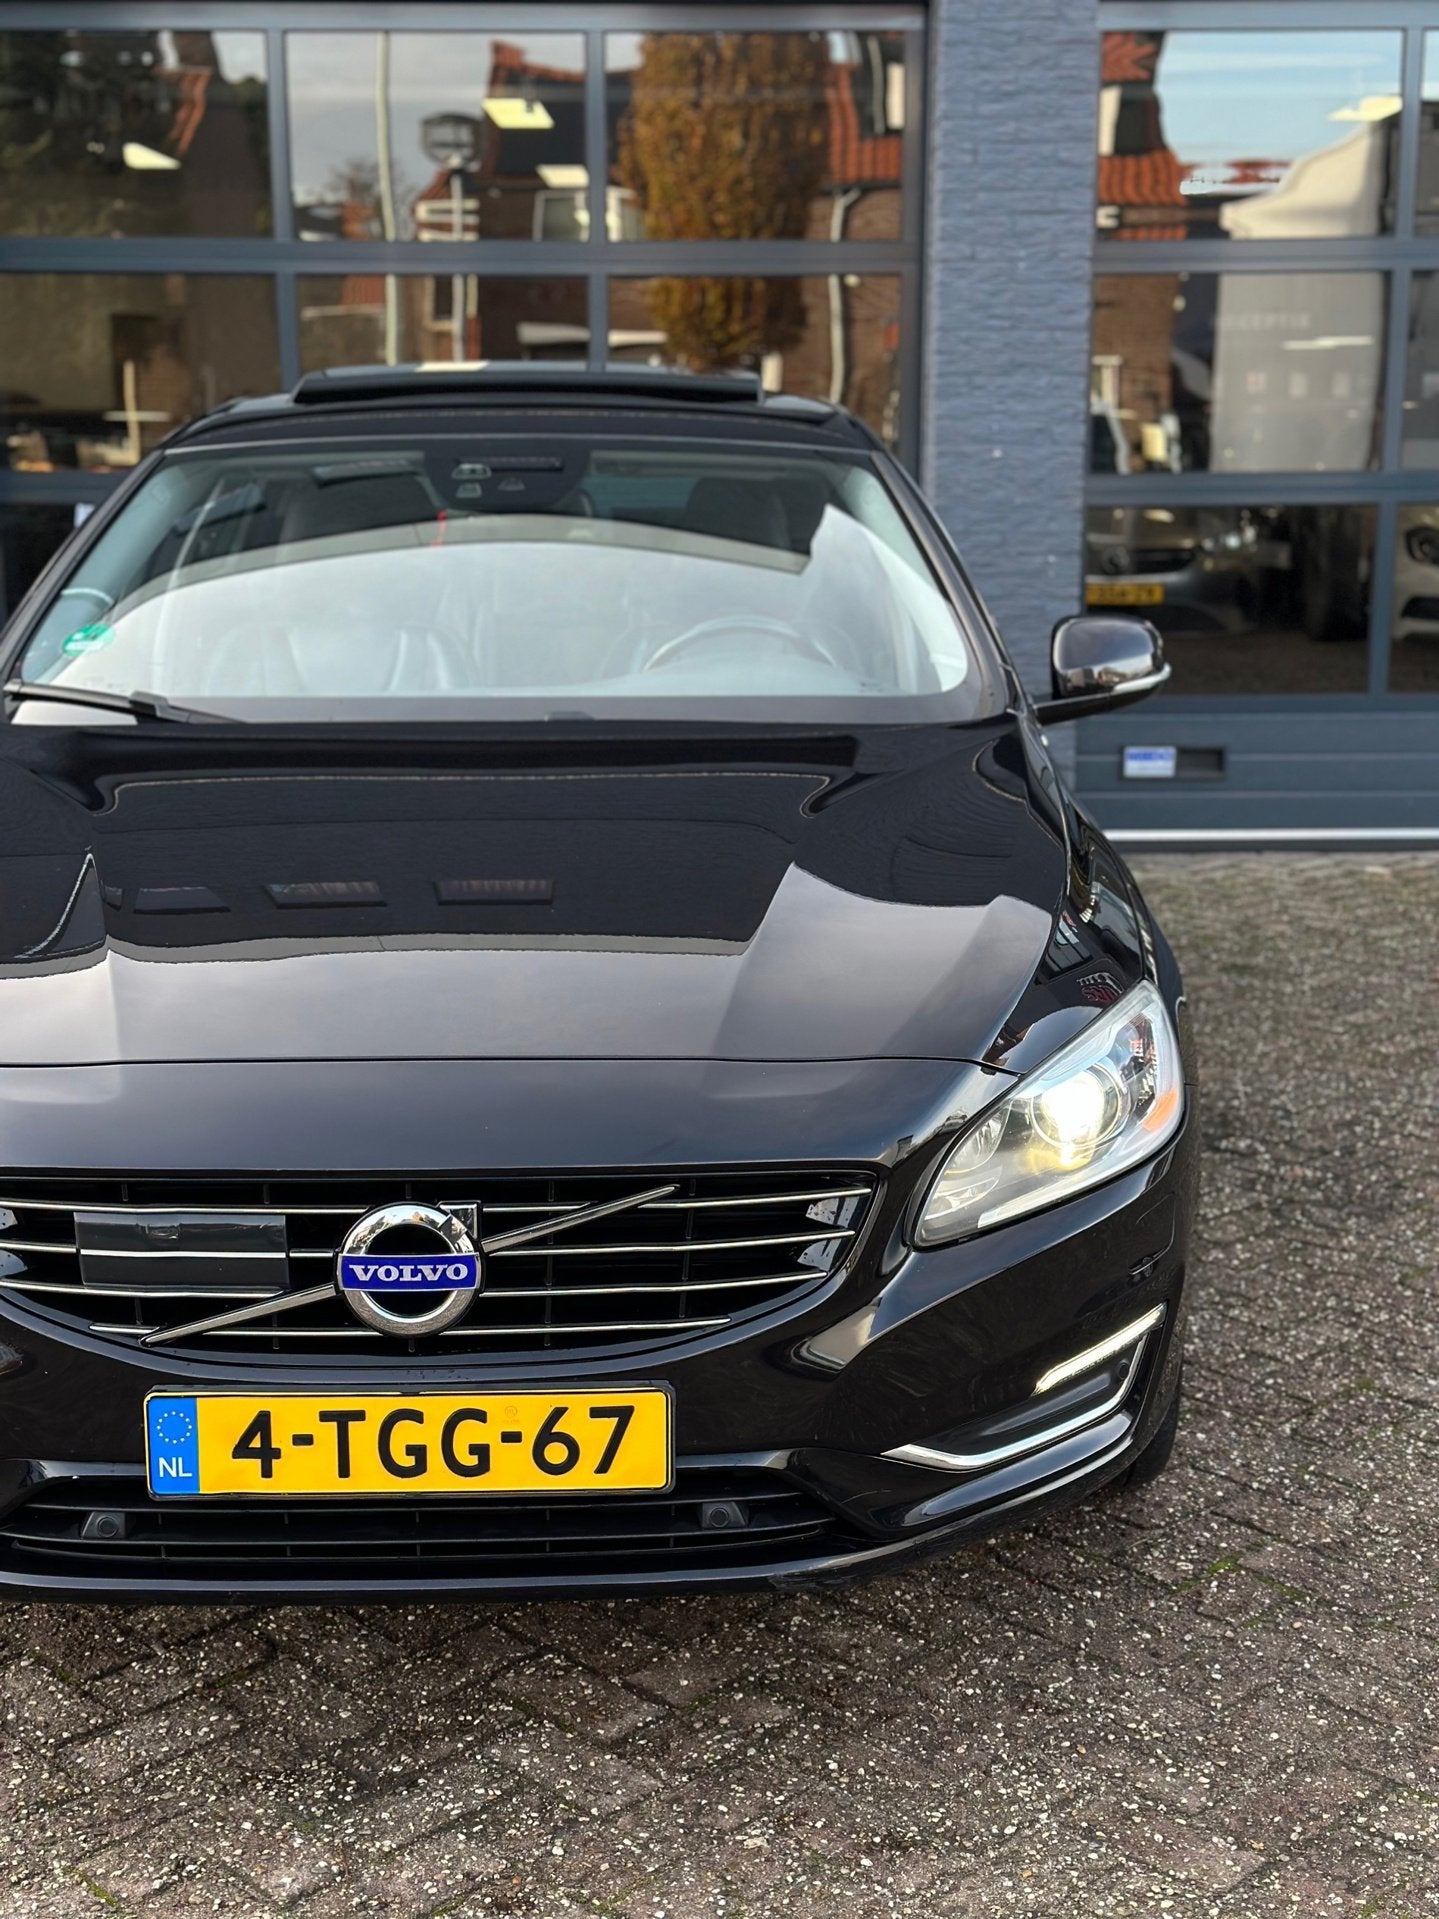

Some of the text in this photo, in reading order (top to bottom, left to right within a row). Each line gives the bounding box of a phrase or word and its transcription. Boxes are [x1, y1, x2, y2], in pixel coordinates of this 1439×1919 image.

[349, 1263, 468, 1282] VOLVO
[231, 1405, 635, 1479] 4-TGG-67
[158, 1456, 193, 1478] NL
